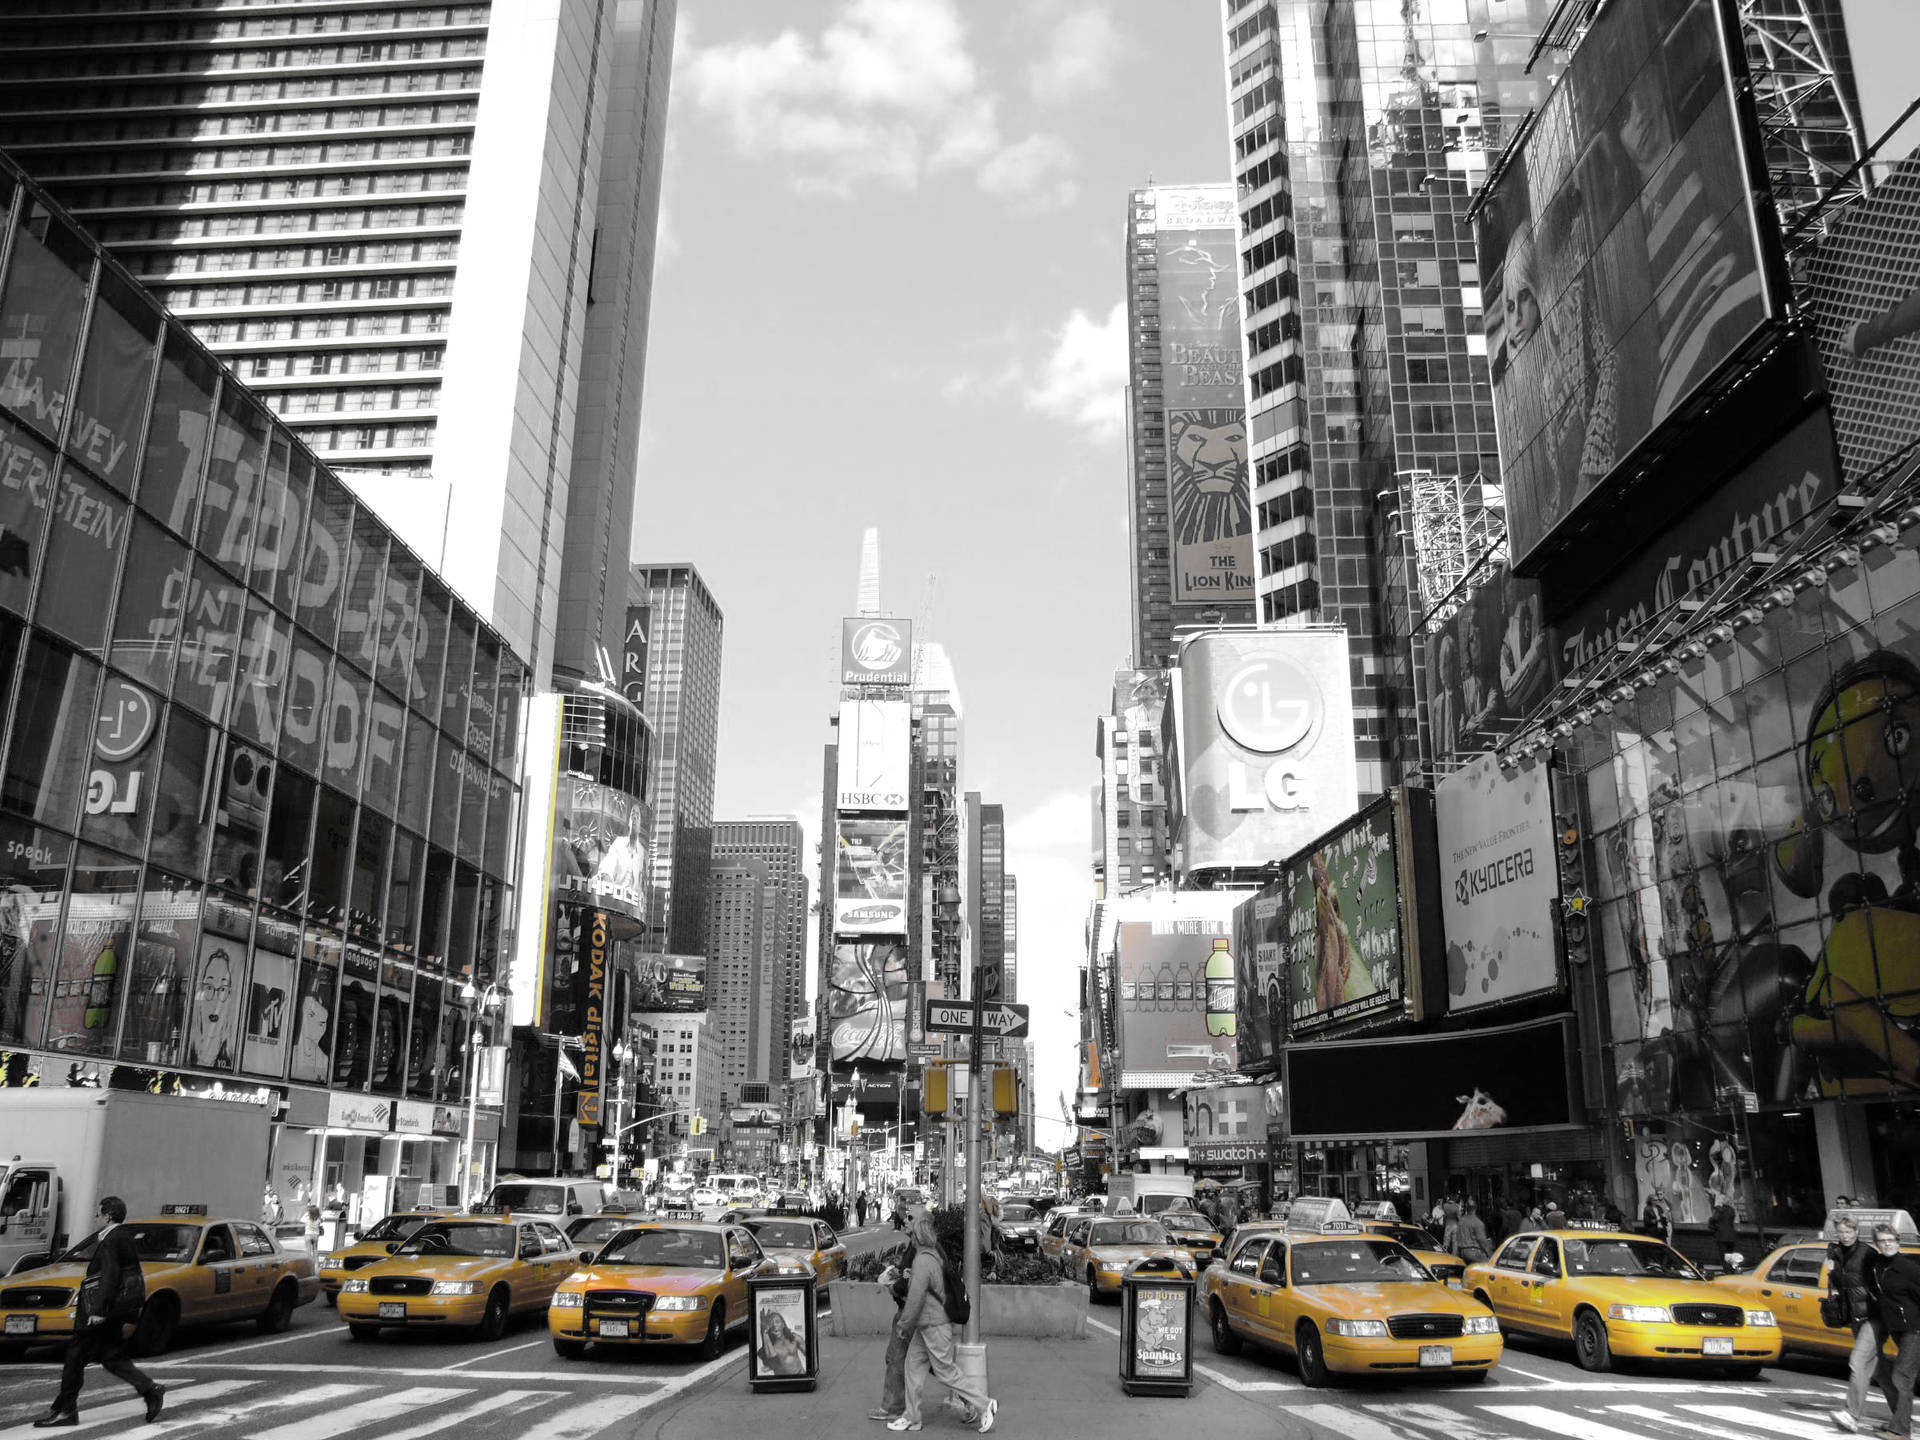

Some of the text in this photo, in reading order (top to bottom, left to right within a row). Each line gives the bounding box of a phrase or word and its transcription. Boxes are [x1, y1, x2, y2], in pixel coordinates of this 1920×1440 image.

[0, 429, 125, 549] IERSTEIN
[1210, 555, 1235, 567] THE
[1185, 572, 1220, 591] LION
[846, 671, 907, 683] Prudential
[1228, 759, 1310, 813] LG
[841, 792, 882, 805] HSBC
[7, 840, 52, 865] speak
[847, 910, 895, 919] SAMSUNG
[1177, 921, 1199, 935] MORE
[345, 947, 378, 970] anguage
[582, 912, 608, 1086] KODAK digital
[940, 1010, 1017, 1026] ONE WAY
[1206, 1146, 1257, 1161] swatch
[1136, 1348, 1183, 1363] Spanky's
